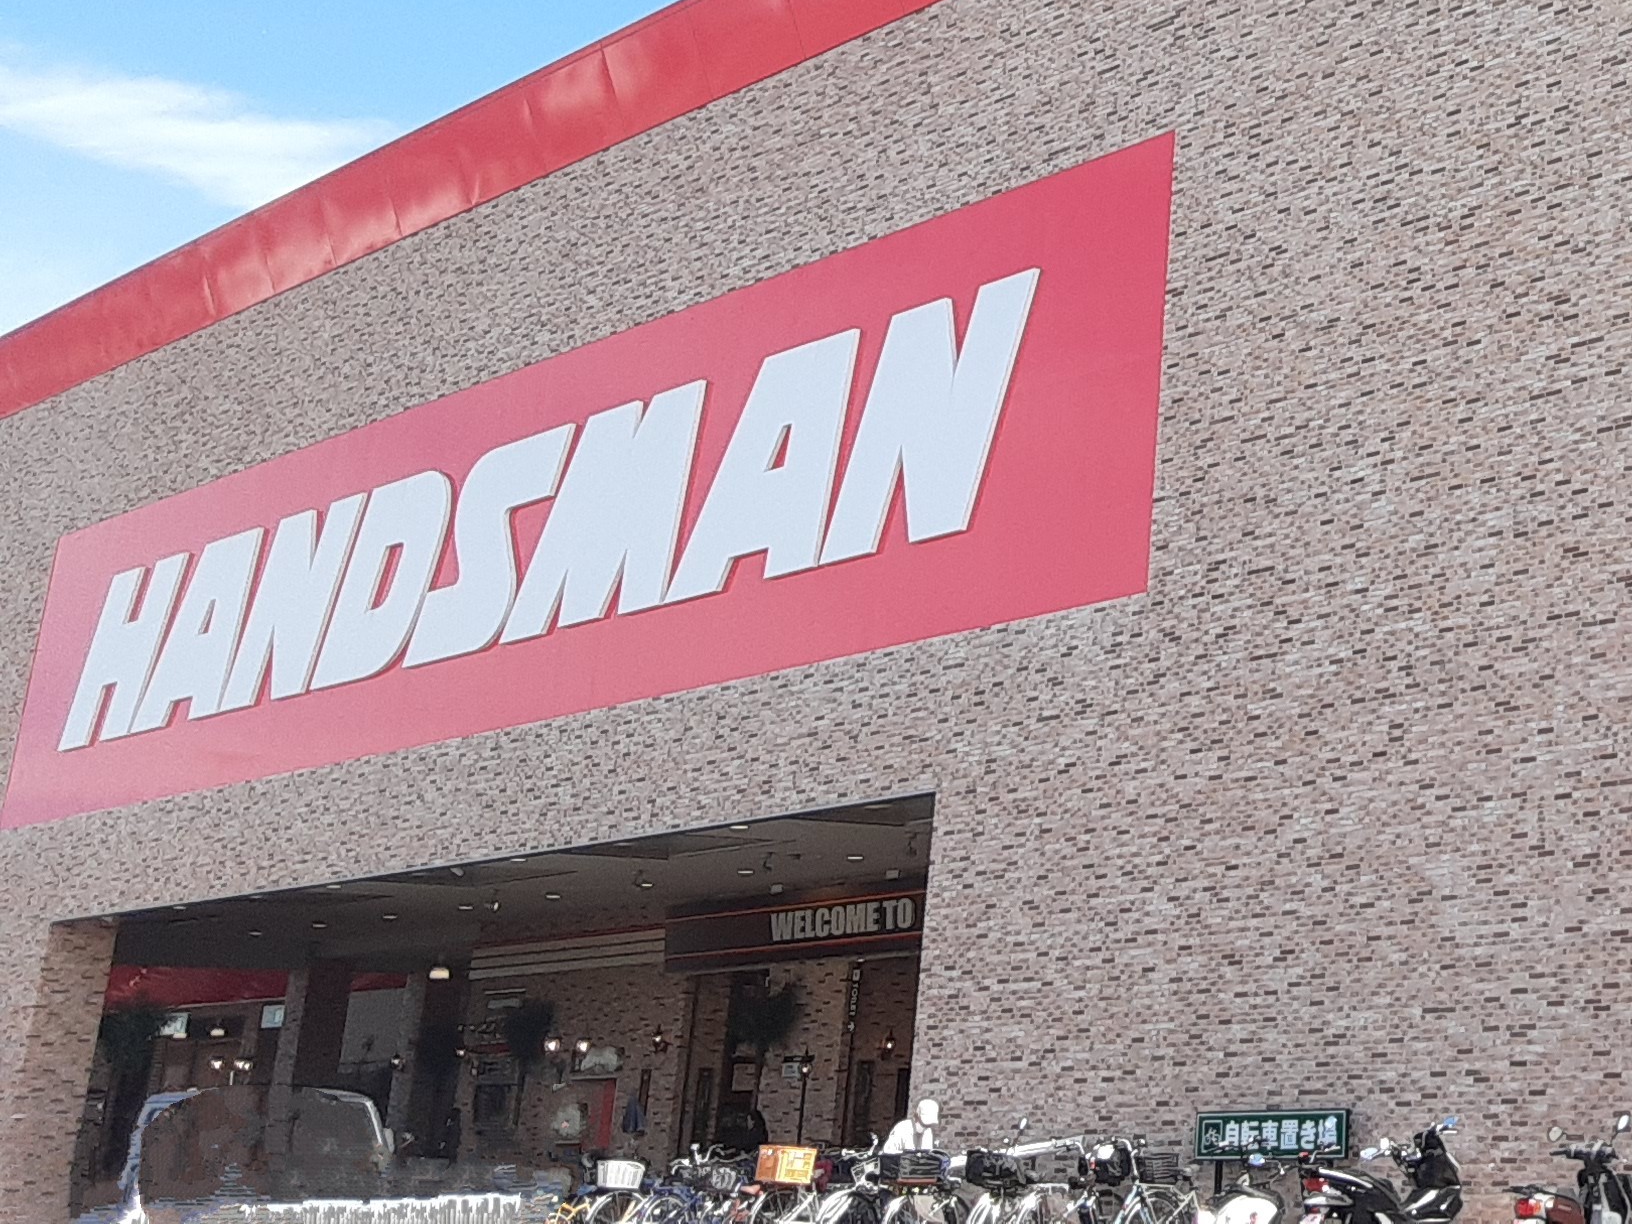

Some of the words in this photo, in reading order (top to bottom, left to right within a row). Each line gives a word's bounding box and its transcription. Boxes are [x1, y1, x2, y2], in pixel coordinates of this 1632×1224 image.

[57, 267, 1041, 752] HANDSMAN
[770, 901, 881, 942] WELCOME
[882, 897, 915, 930] TO
